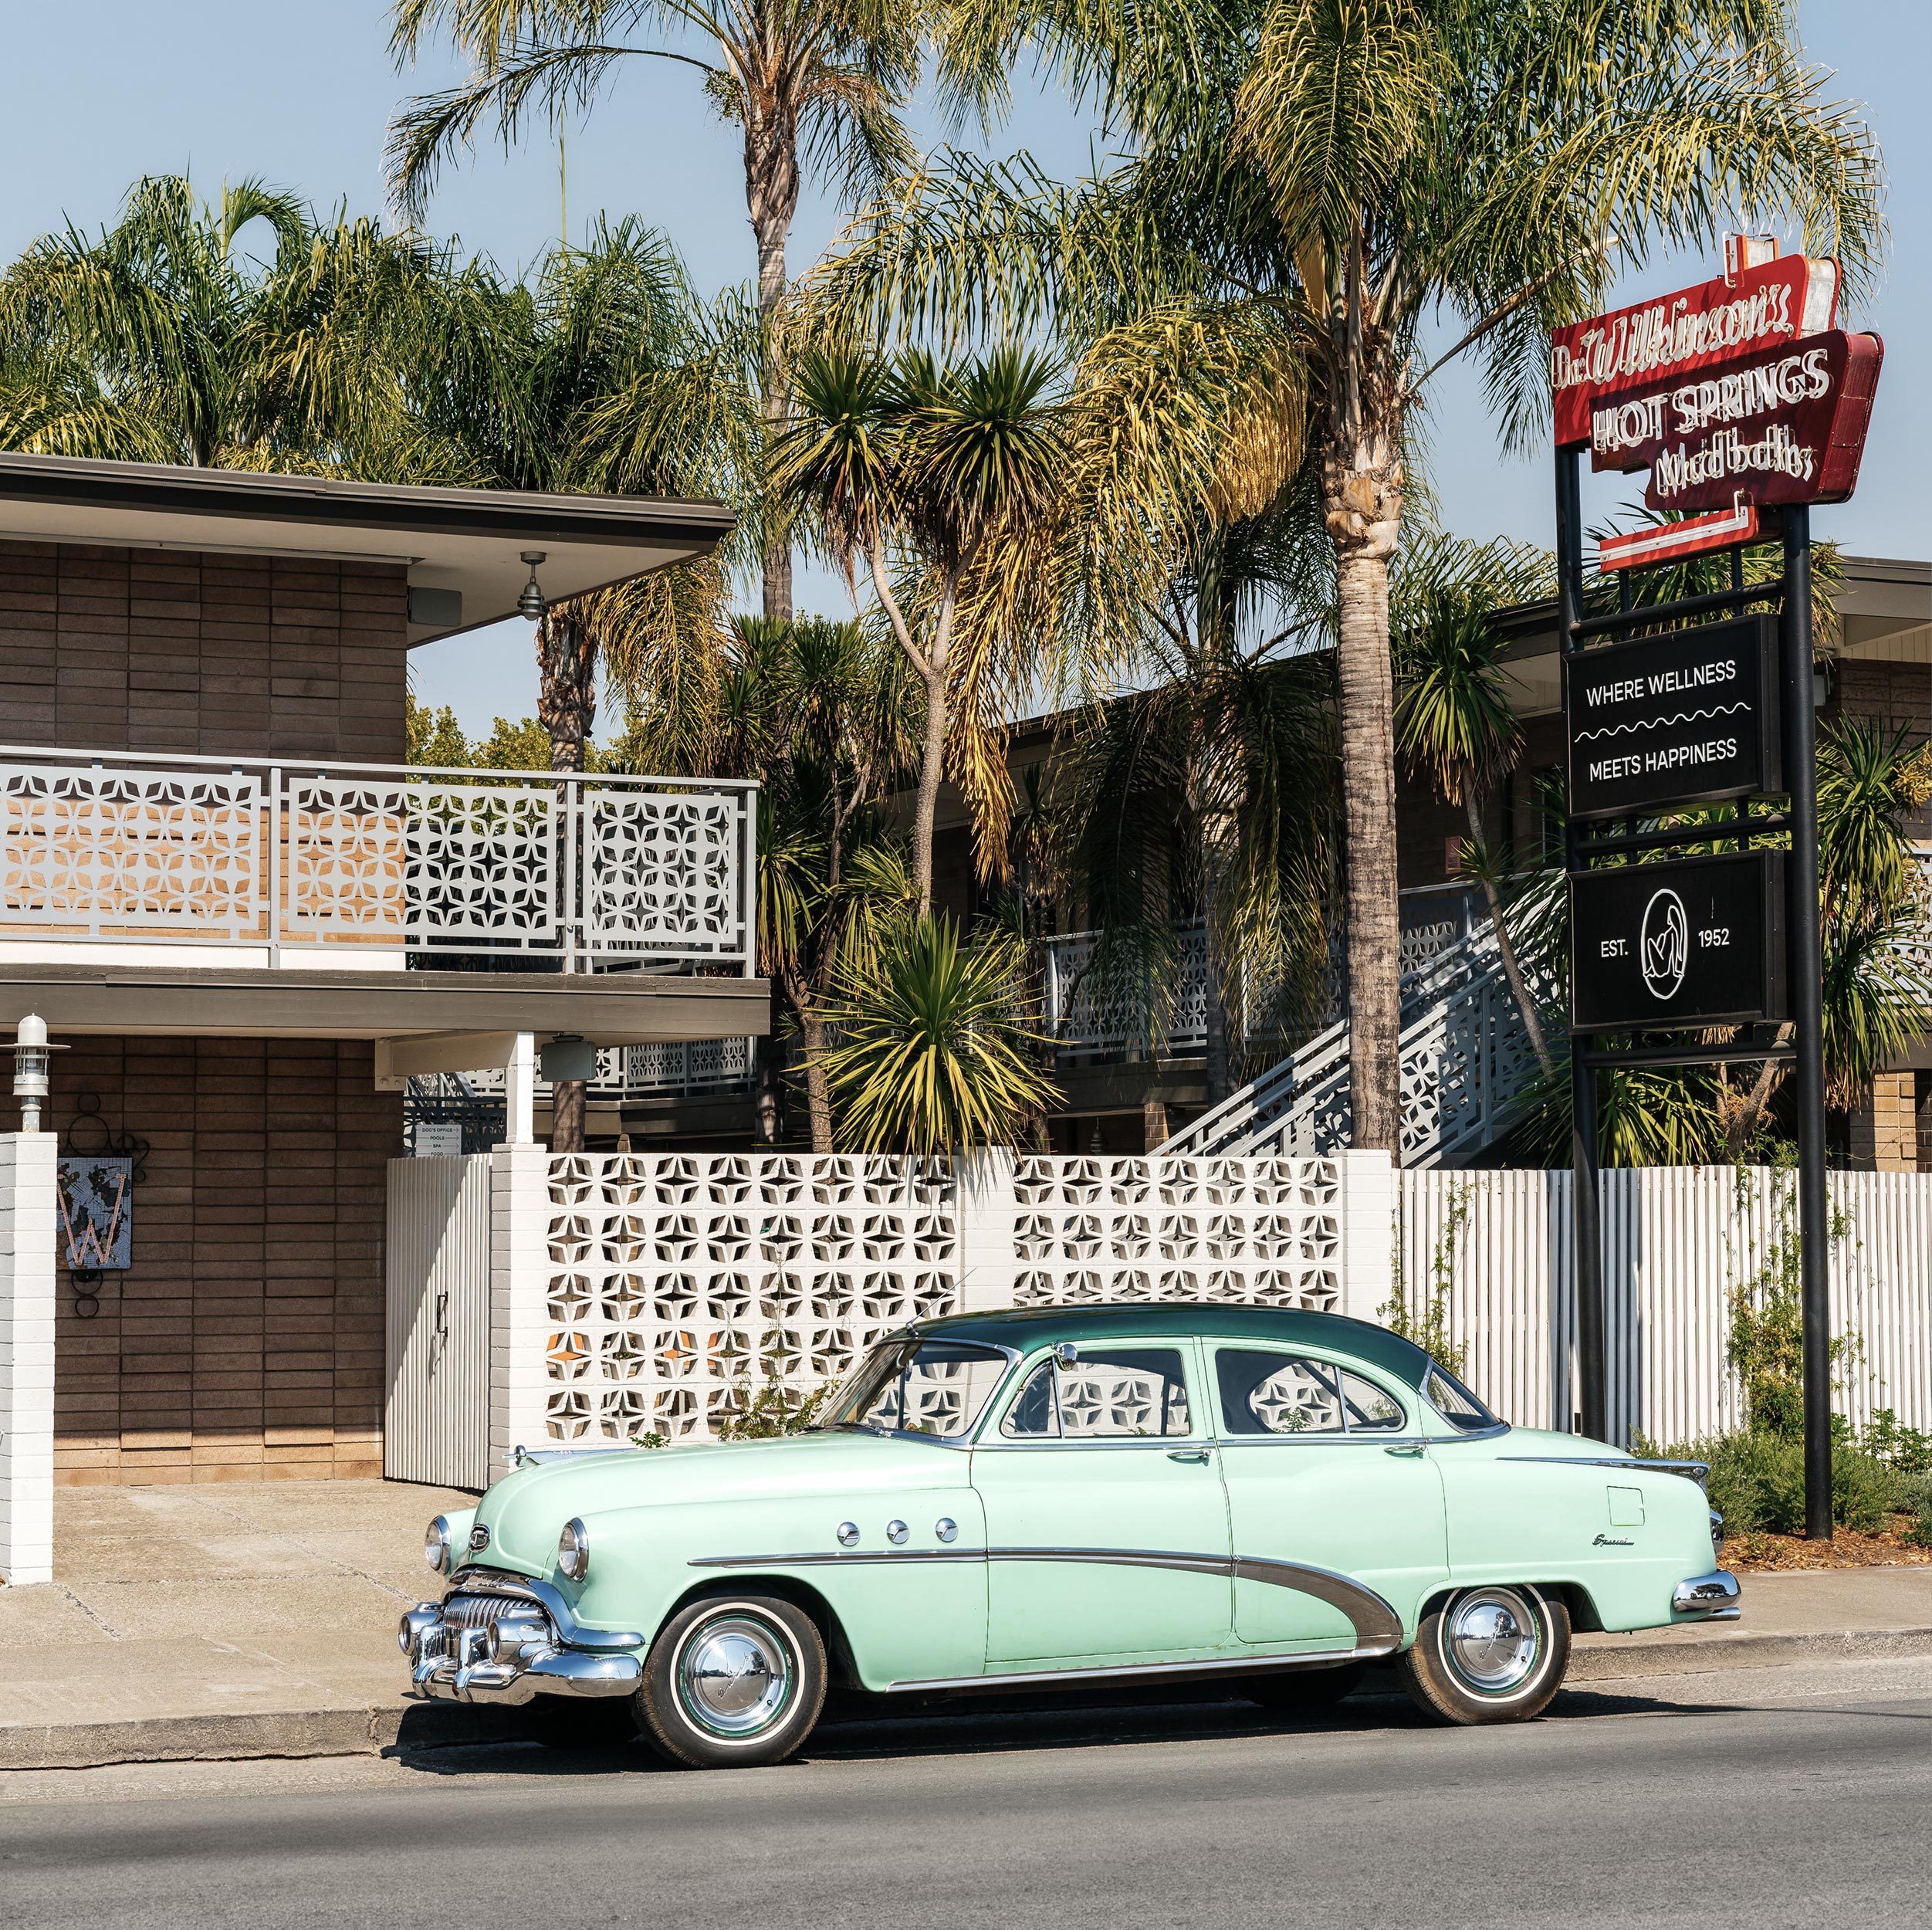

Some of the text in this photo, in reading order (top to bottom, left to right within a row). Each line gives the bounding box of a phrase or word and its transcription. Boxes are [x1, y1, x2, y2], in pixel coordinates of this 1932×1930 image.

[1580, 283, 1794, 385] Wilkinson's
[1593, 348, 1829, 454] HOT SPRINGS
[1586, 660, 1736, 706] WHERE WELLNESS
[1589, 738, 1737, 782] MEETS HAPPINESS
[1601, 928, 1730, 957] EST. 1952
